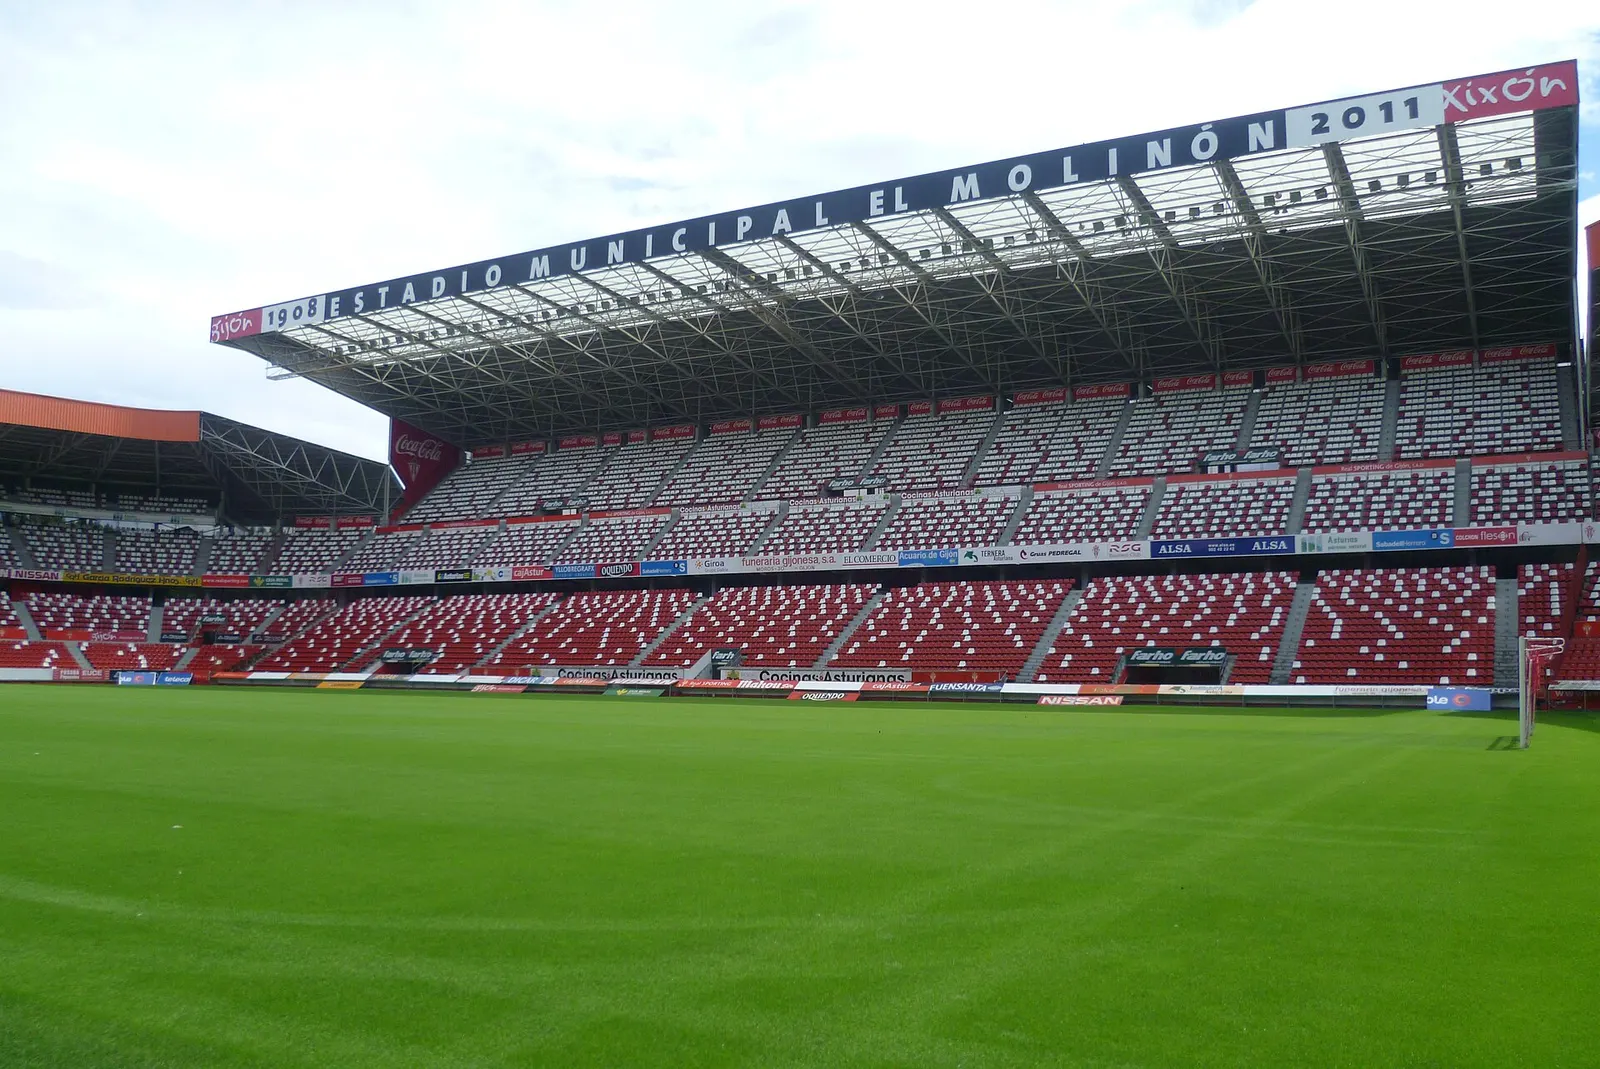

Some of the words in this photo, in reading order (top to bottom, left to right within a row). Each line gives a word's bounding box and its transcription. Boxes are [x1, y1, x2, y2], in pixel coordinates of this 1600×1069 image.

[1311, 96, 1419, 135] 2011
[330, 265, 502, 318] ESTADIO
[529, 201, 829, 279] MUNICIPAL
[869, 186, 908, 216] EL
[950, 120, 1274, 202] MOLINÓN
[268, 298, 318, 328] 1908
[395, 433, 443, 462] Coca-Cola
[1203, 451, 1236, 462] farho
[1243, 450, 1278, 460] farho
[934, 489, 974, 498] Asturianas
[1440, 532, 1450, 544] S
[1110, 544, 1141, 552] RSG
[1158, 544, 1192, 554] ALSA
[1252, 540, 1288, 550] ALSA
[854, 554, 896, 563] COMERCIO
[900, 551, 926, 560] Acuario
[928, 550, 938, 558] de
[742, 557, 780, 566] funeraria
[514, 568, 544, 578] cajAstur
[602, 563, 633, 576] OQUENDO
[15, 570, 59, 580] NISSAN
[1130, 650, 1174, 660] farho
[1180, 650, 1226, 660] farho
[611, 668, 678, 680] Asturianas
[760, 670, 818, 682] Cocinas
[824, 670, 905, 682] Asturianas
[736, 680, 782, 688] Mahou
[929, 683, 986, 692] FUENSANTA
[802, 692, 845, 701] OQUENDO
[1040, 696, 1120, 705] NISSAN
